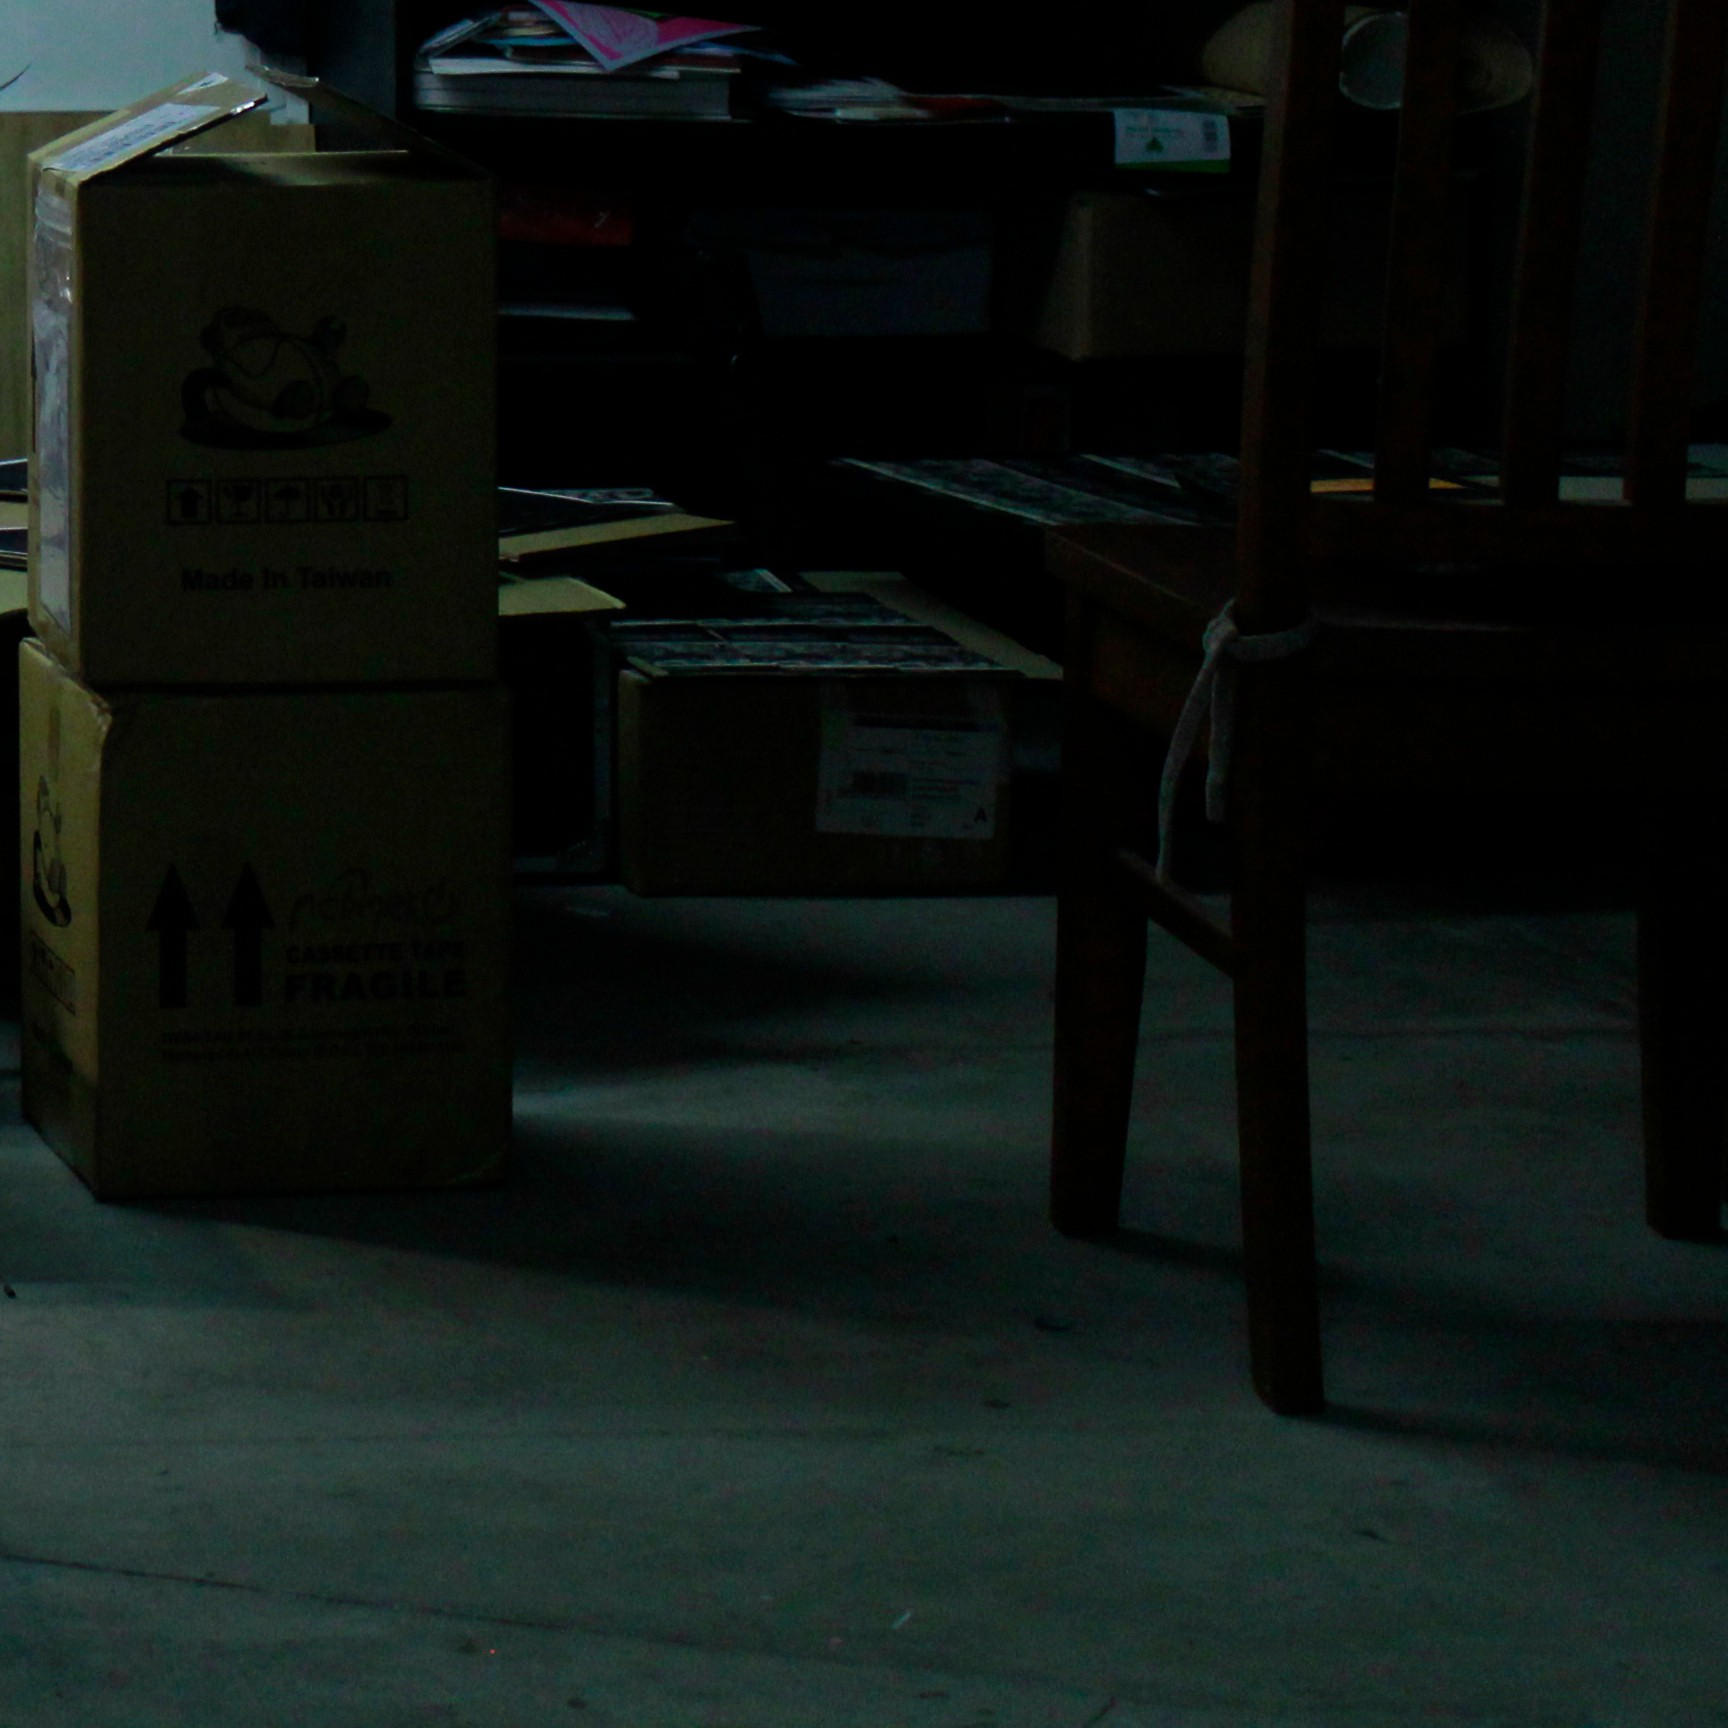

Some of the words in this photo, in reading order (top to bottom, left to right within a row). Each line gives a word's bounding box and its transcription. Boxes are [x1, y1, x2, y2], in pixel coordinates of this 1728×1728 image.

[181, 568, 254, 592] Made
[297, 566, 392, 590] Taiwan
[286, 942, 402, 965] CASSETTE
[411, 941, 465, 961] TAPE
[286, 969, 467, 1003] FRAGILE
